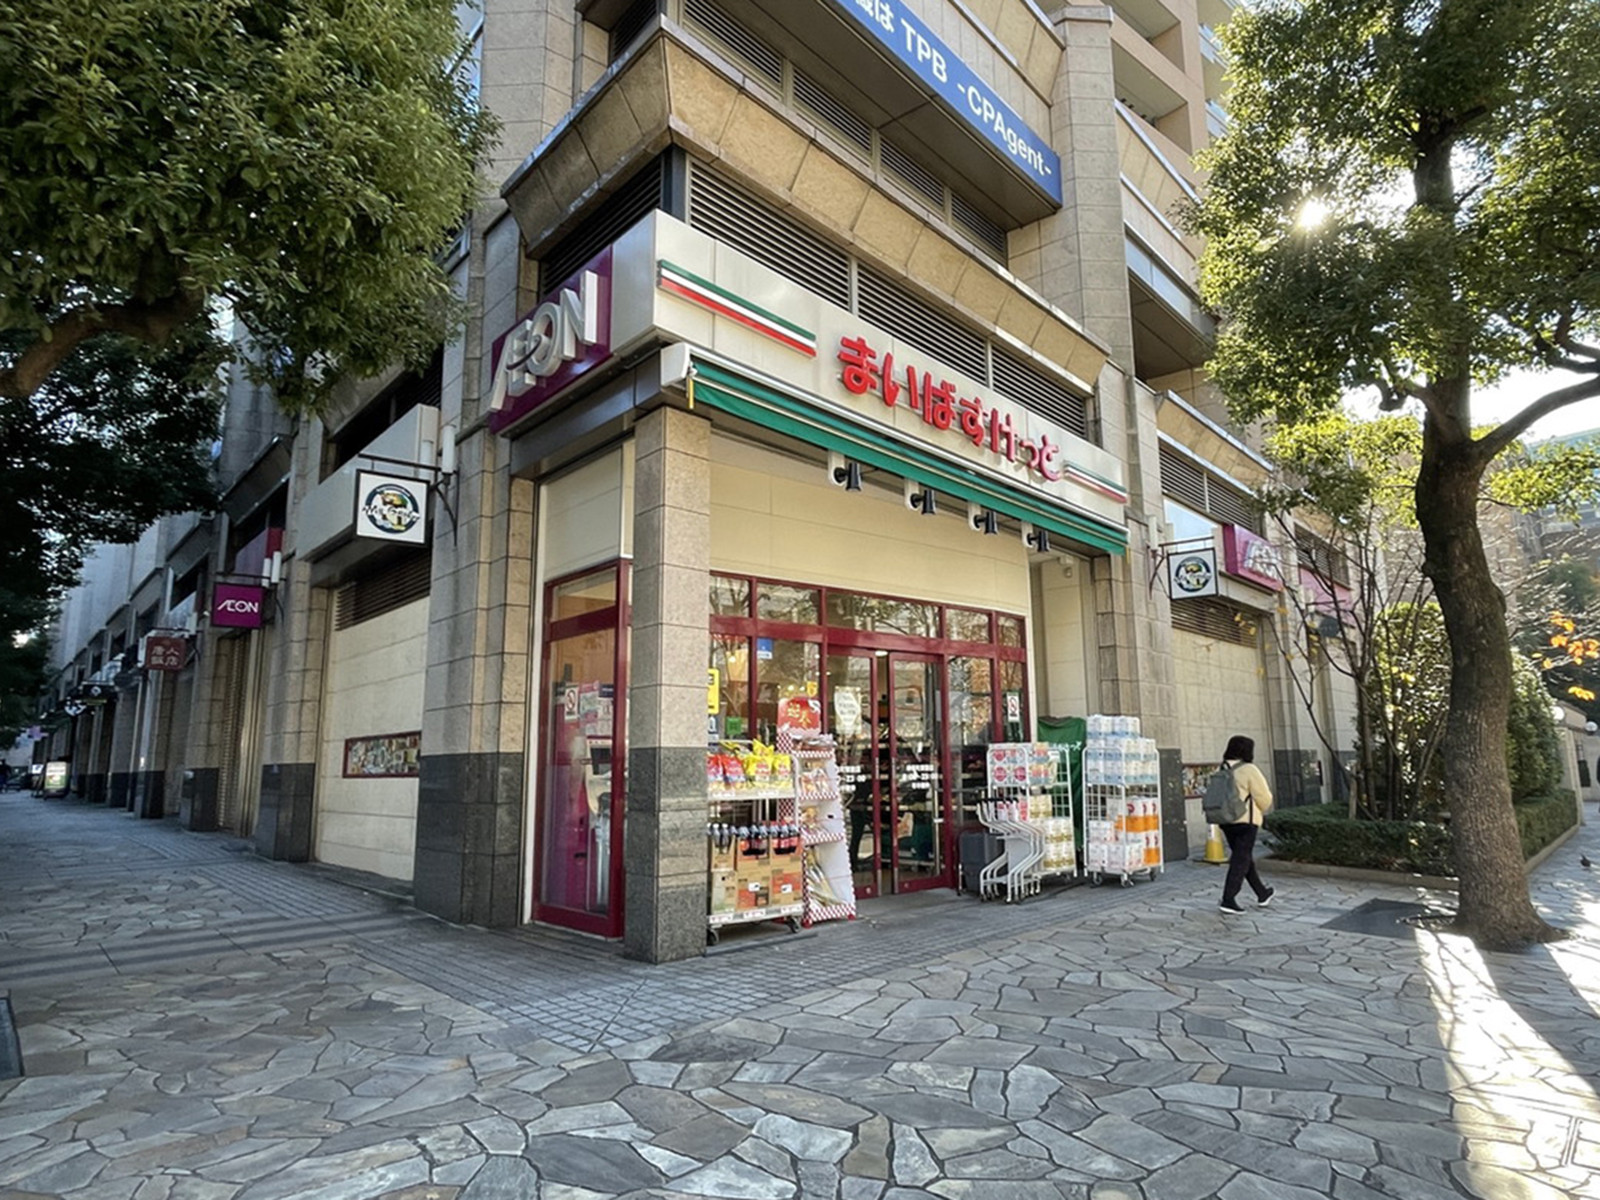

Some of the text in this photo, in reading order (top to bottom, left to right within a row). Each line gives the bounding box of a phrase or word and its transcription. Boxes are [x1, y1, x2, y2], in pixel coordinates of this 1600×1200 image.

[900, 18, 948, 83] TPB
[837, 336, 1063, 482] まいばすけっと
